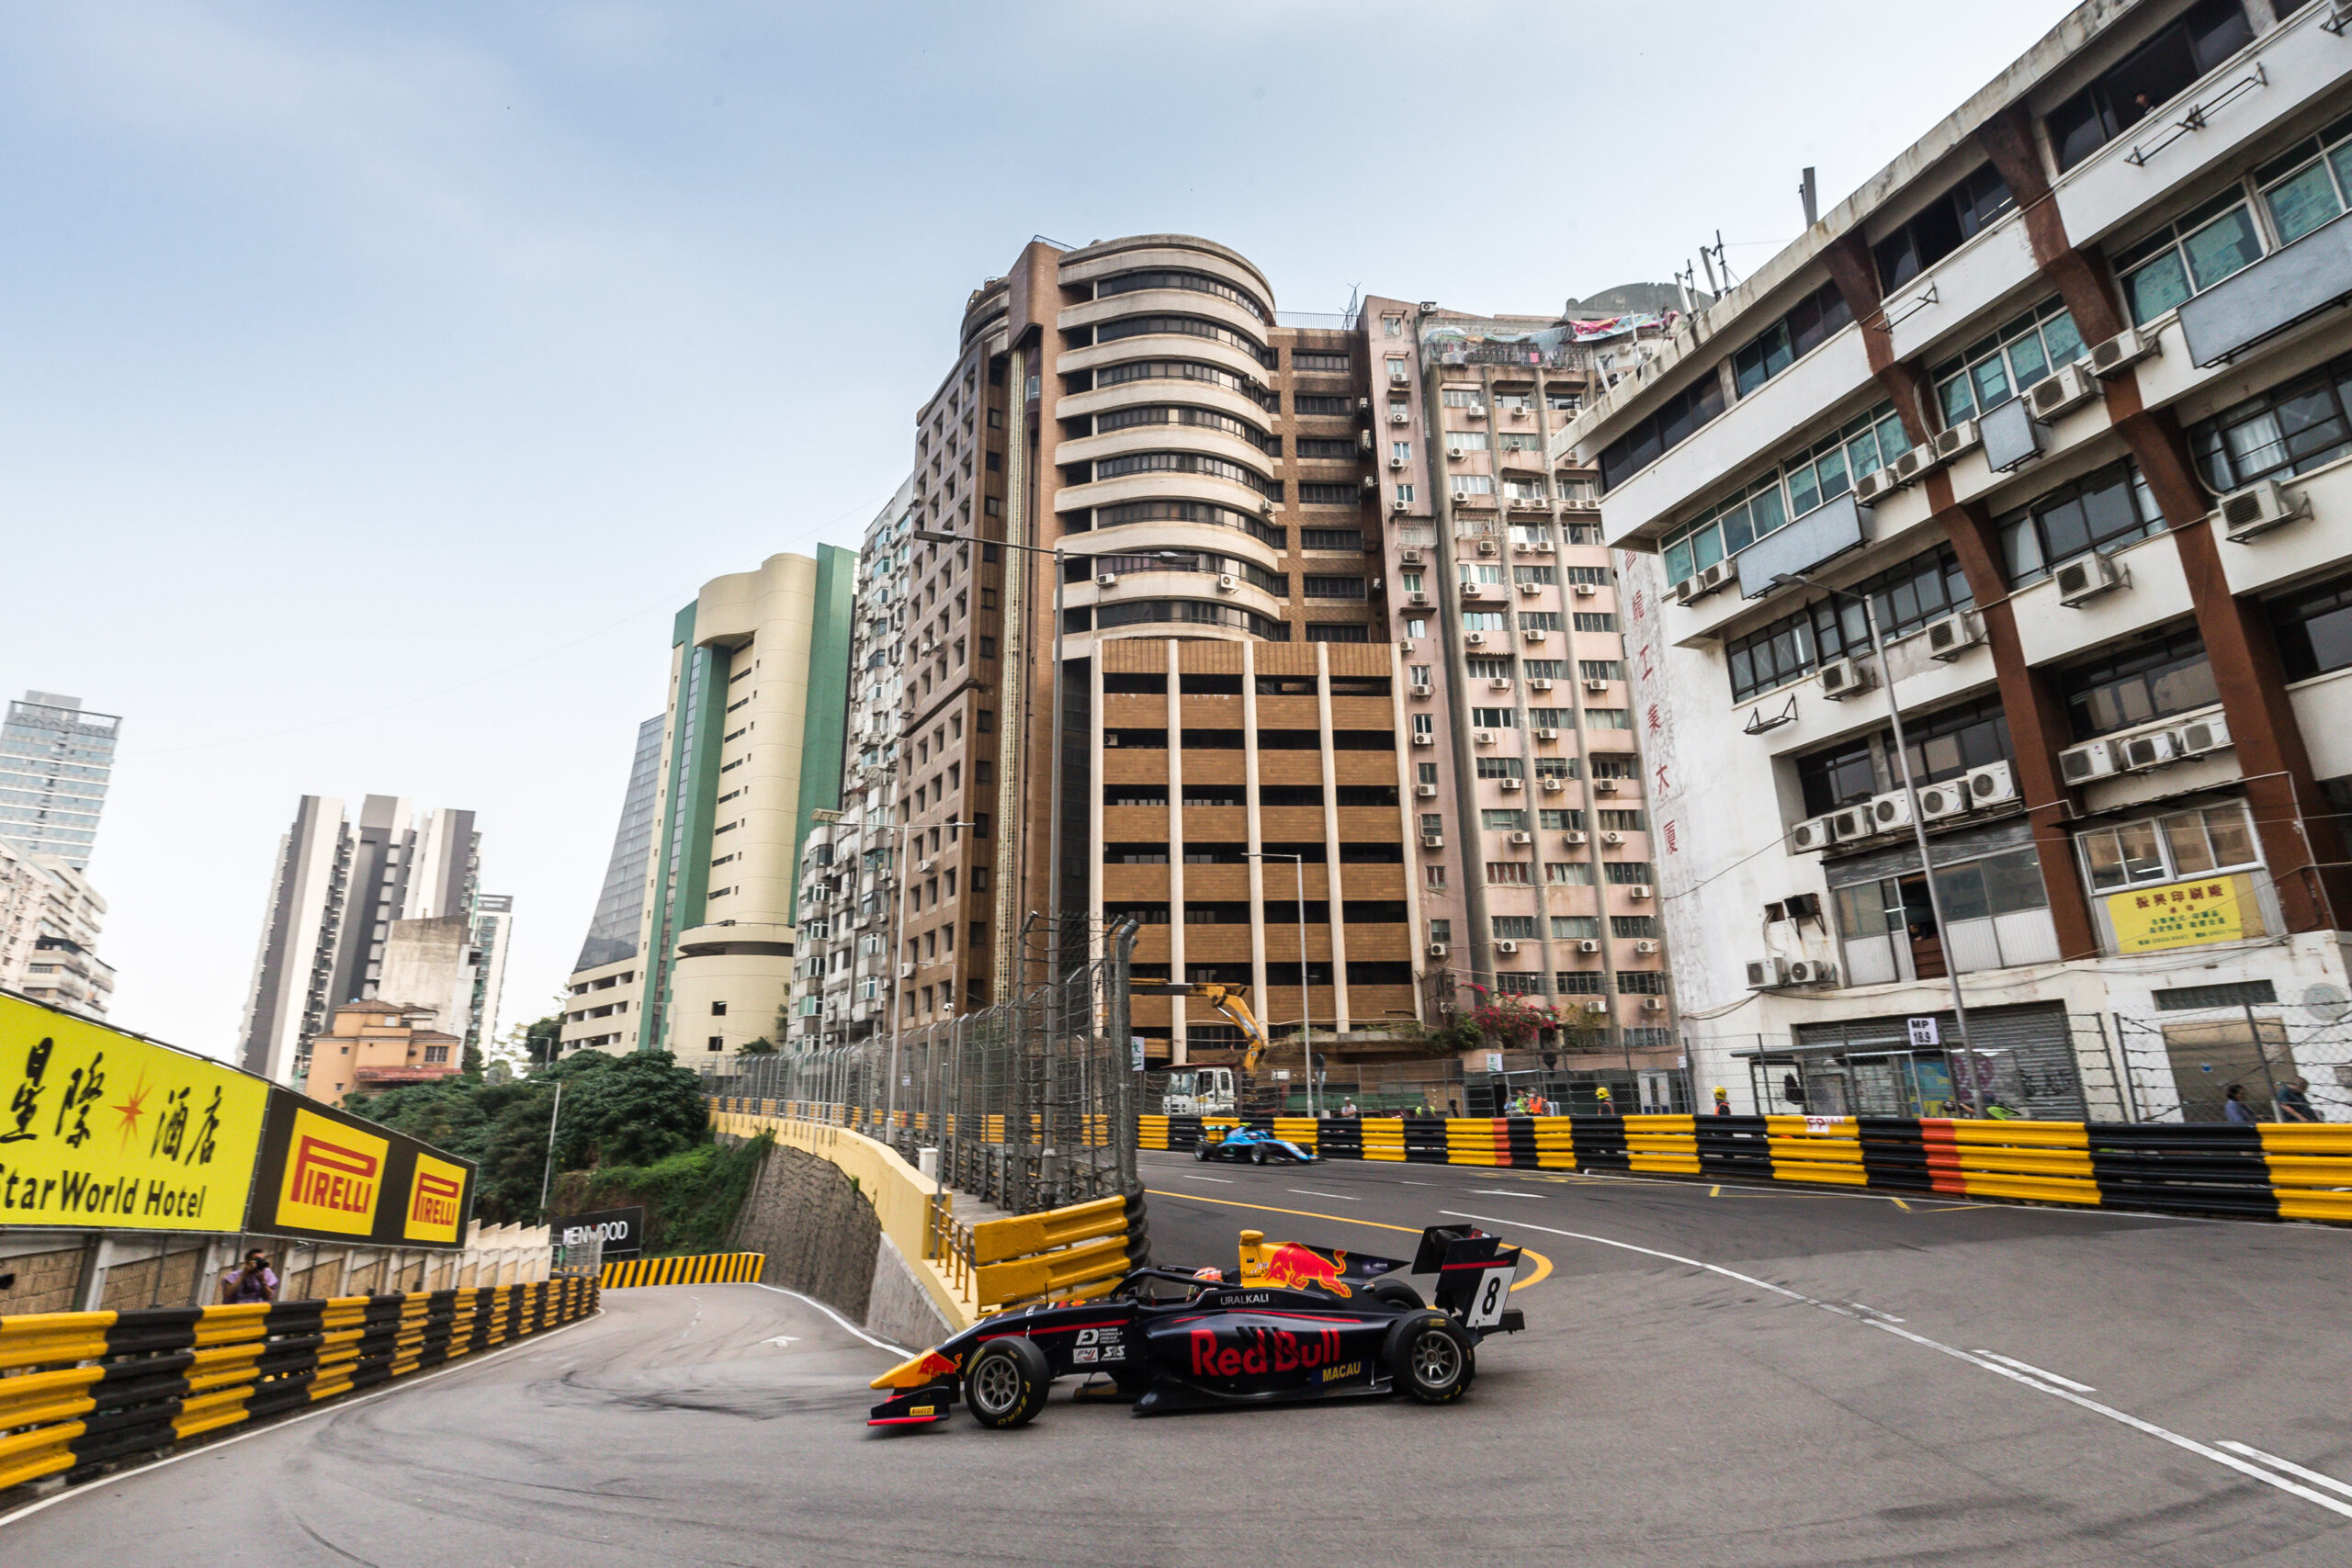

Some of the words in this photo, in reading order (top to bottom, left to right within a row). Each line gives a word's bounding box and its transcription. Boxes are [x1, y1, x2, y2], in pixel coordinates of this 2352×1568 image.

[1911, 1020, 1929, 1029] MP
[291, 1134, 378, 1215] PIRELLI
[144, 1179, 207, 1218] Hotel
[413, 1171, 460, 1227] PIRELLI
[1220, 1292, 1270, 1305] URALKALI
[1482, 1277, 1501, 1315] 8
[1191, 1328, 1268, 1377] Red
[1273, 1326, 1341, 1372] Bull
[1322, 1360, 1362, 1382] MACAU
